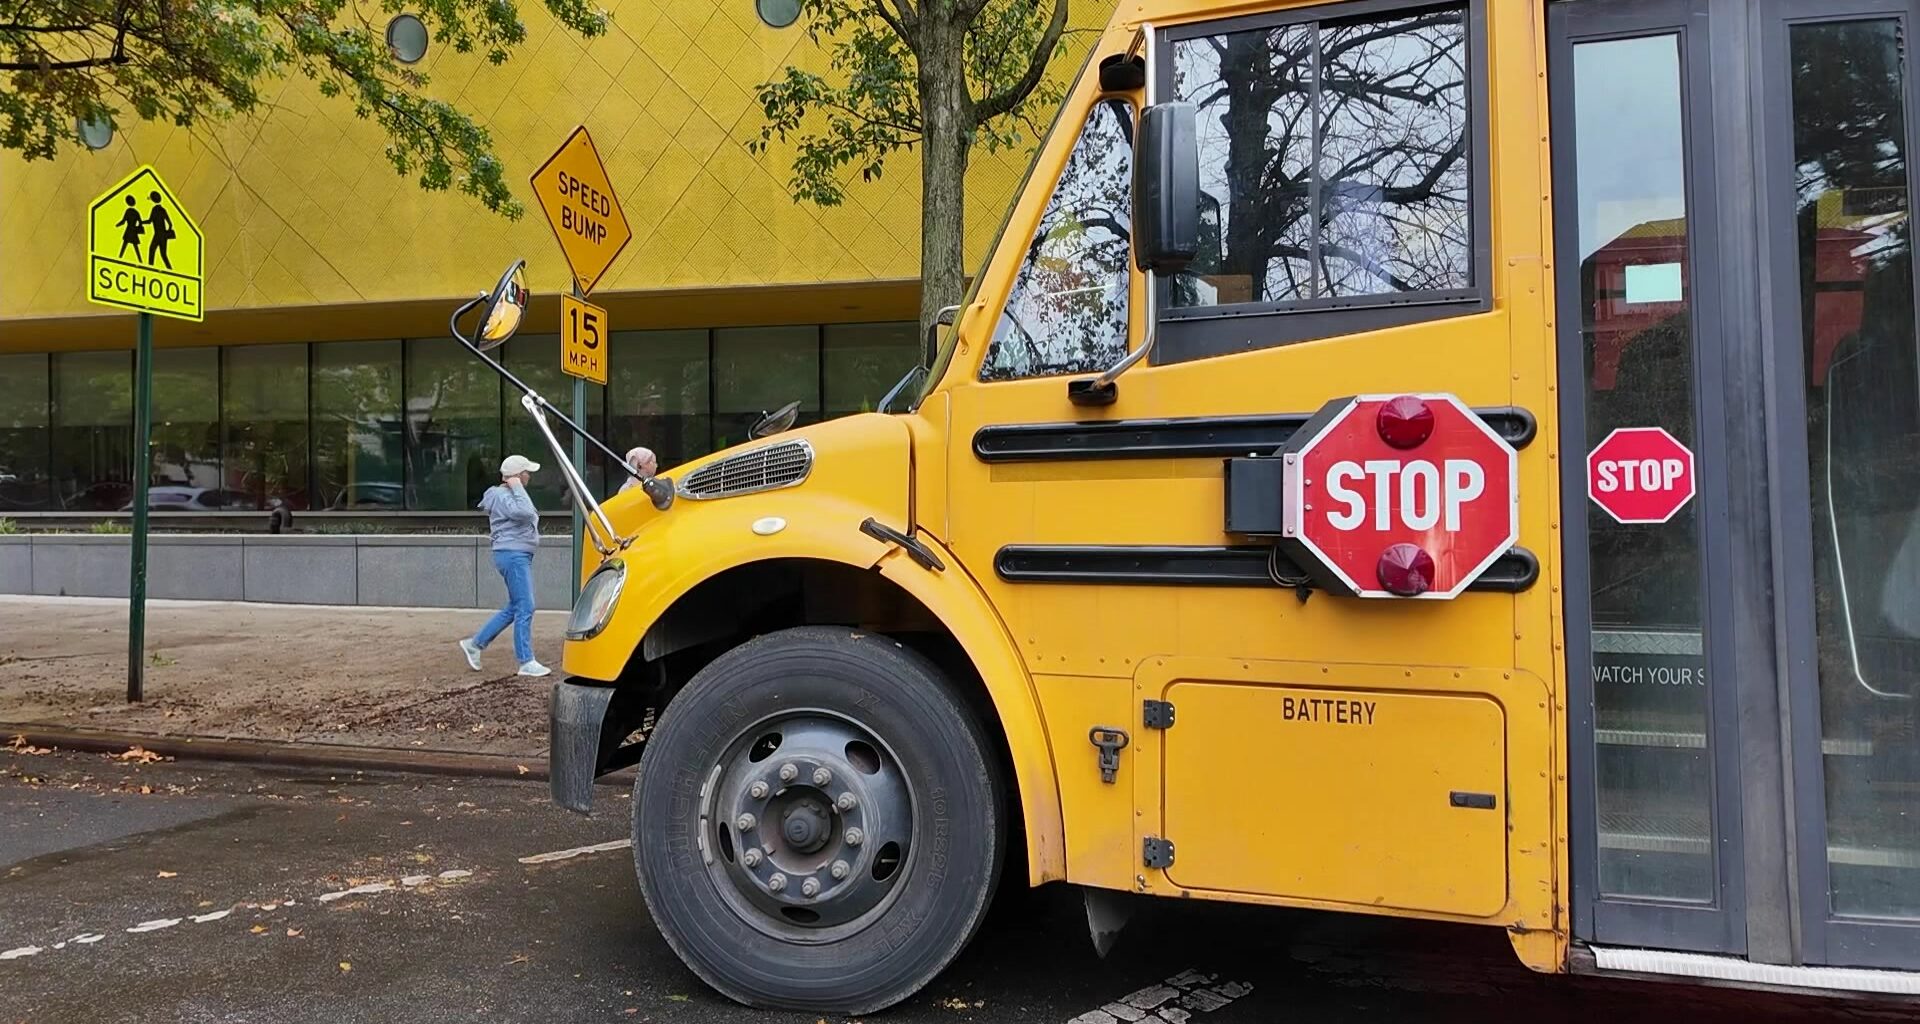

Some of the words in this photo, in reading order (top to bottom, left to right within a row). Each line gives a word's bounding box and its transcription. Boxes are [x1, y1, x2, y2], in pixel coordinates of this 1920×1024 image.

[559, 171, 610, 217] SPEED
[562, 205, 607, 245] BUMP
[99, 267, 195, 306] SCHOOL
[571, 307, 598, 350] 15
[1597, 458, 1684, 492] STOP
[1326, 459, 1485, 531] STOP
[1647, 667, 1692, 685] YOUR
[1283, 697, 1376, 725] BATTERY
